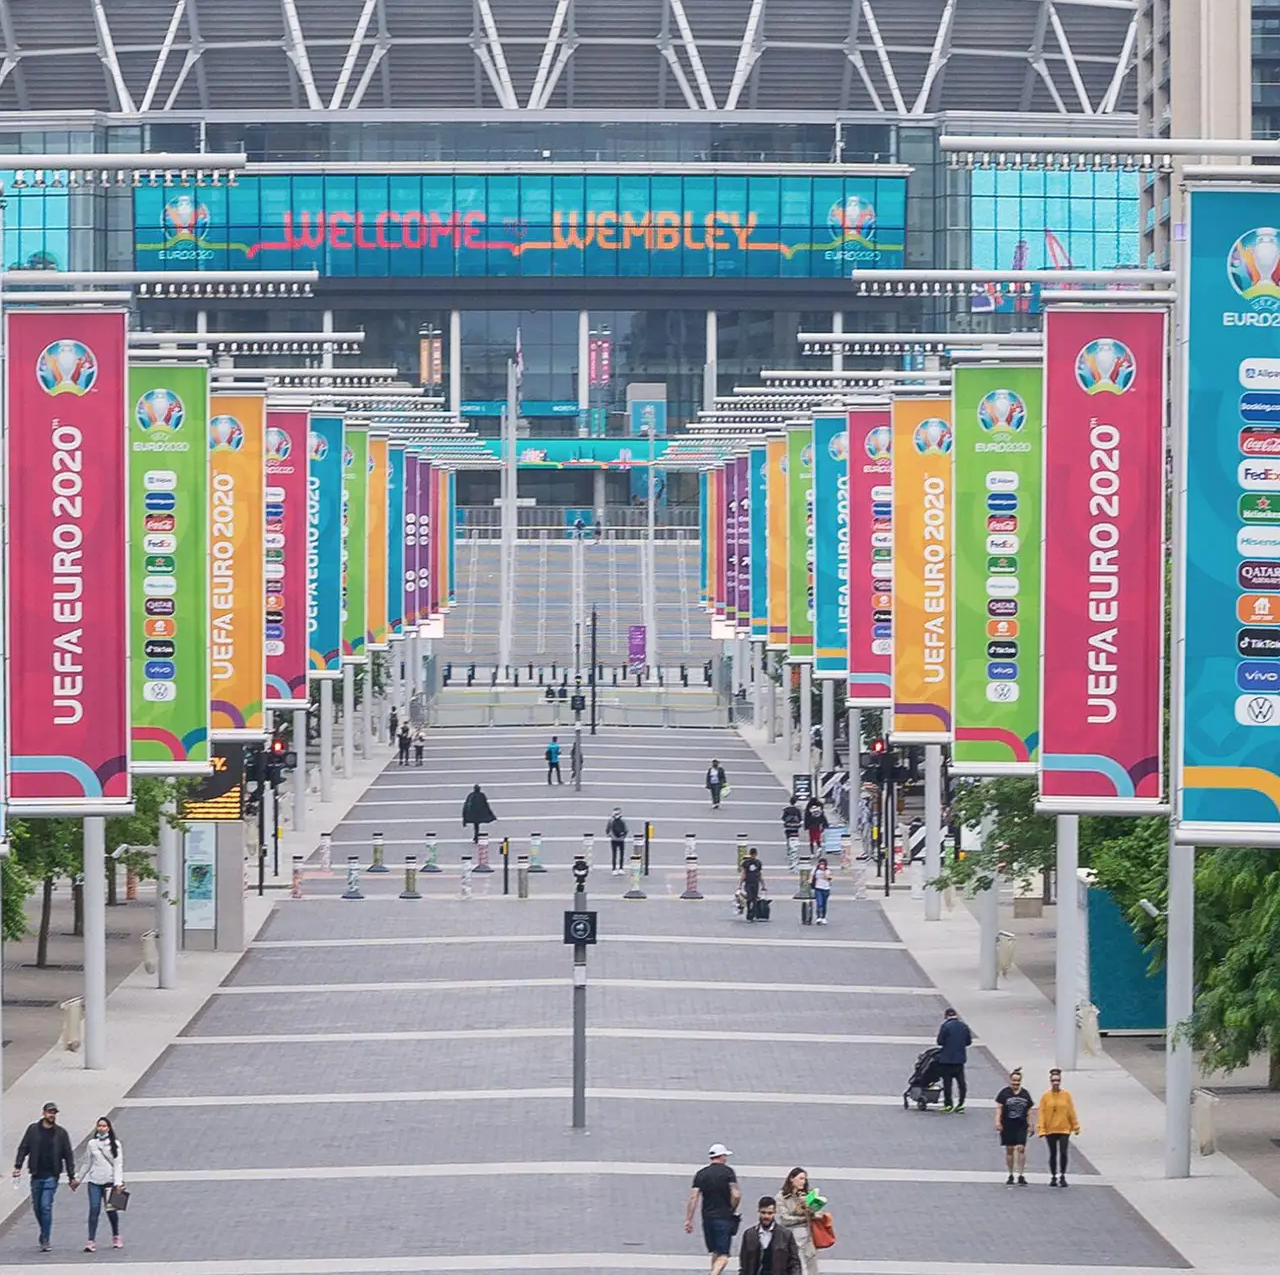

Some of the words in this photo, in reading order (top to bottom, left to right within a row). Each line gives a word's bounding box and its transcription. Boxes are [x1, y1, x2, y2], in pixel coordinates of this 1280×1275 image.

[283, 210, 487, 249] WELCOME
[552, 210, 758, 249] WEMBLEY
[53, 426, 84, 519] 2020
[213, 473, 235, 538] 2020
[1090, 425, 1121, 518] 2020
[924, 476, 945, 541] 2020
[53, 525, 84, 625] EURO
[212, 540, 234, 609] EURO
[924, 544, 946, 613] EURO
[1089, 524, 1120, 624] EURO
[54, 628, 84, 725] UEFA
[212, 613, 234, 680] UEFA
[924, 616, 946, 683] UEFA
[1088, 628, 1119, 725] UEFA
[1245, 671, 1278, 681] vivo
